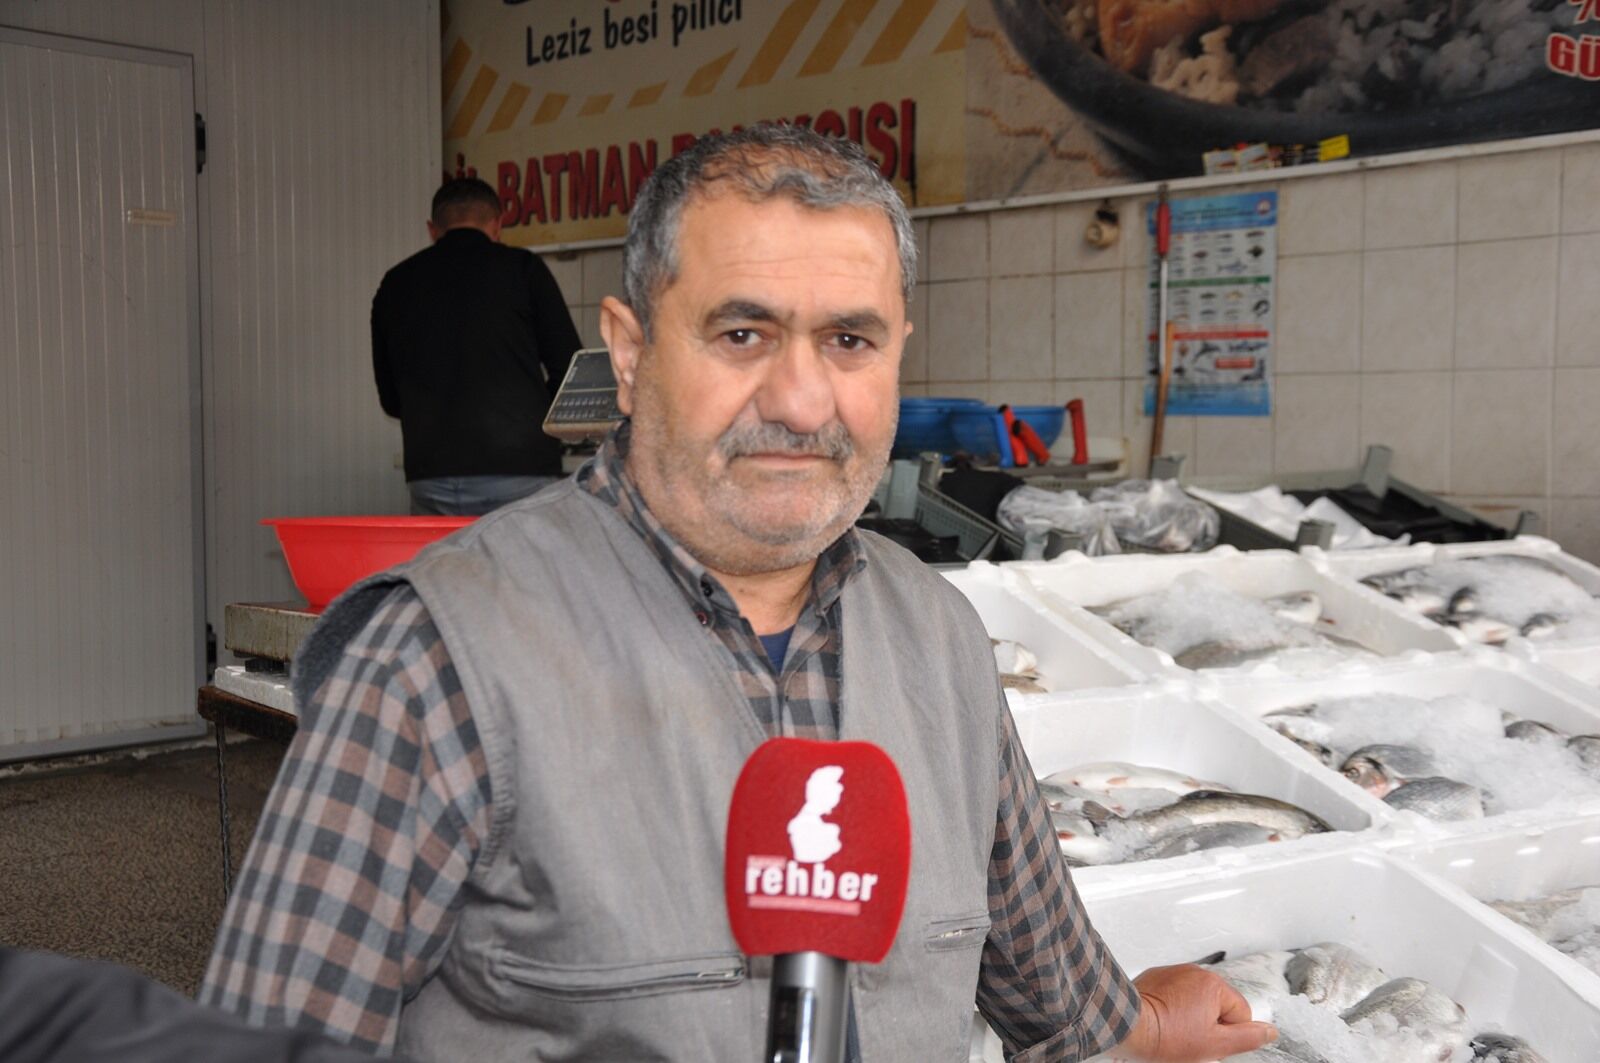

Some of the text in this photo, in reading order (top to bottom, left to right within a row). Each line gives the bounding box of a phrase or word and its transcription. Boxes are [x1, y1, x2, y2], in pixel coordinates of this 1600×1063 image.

[526, 18, 592, 67] Leziz
[604, 2, 658, 49] besi
[498, 139, 658, 229] BATMAN
[745, 860, 878, 902] rehber
